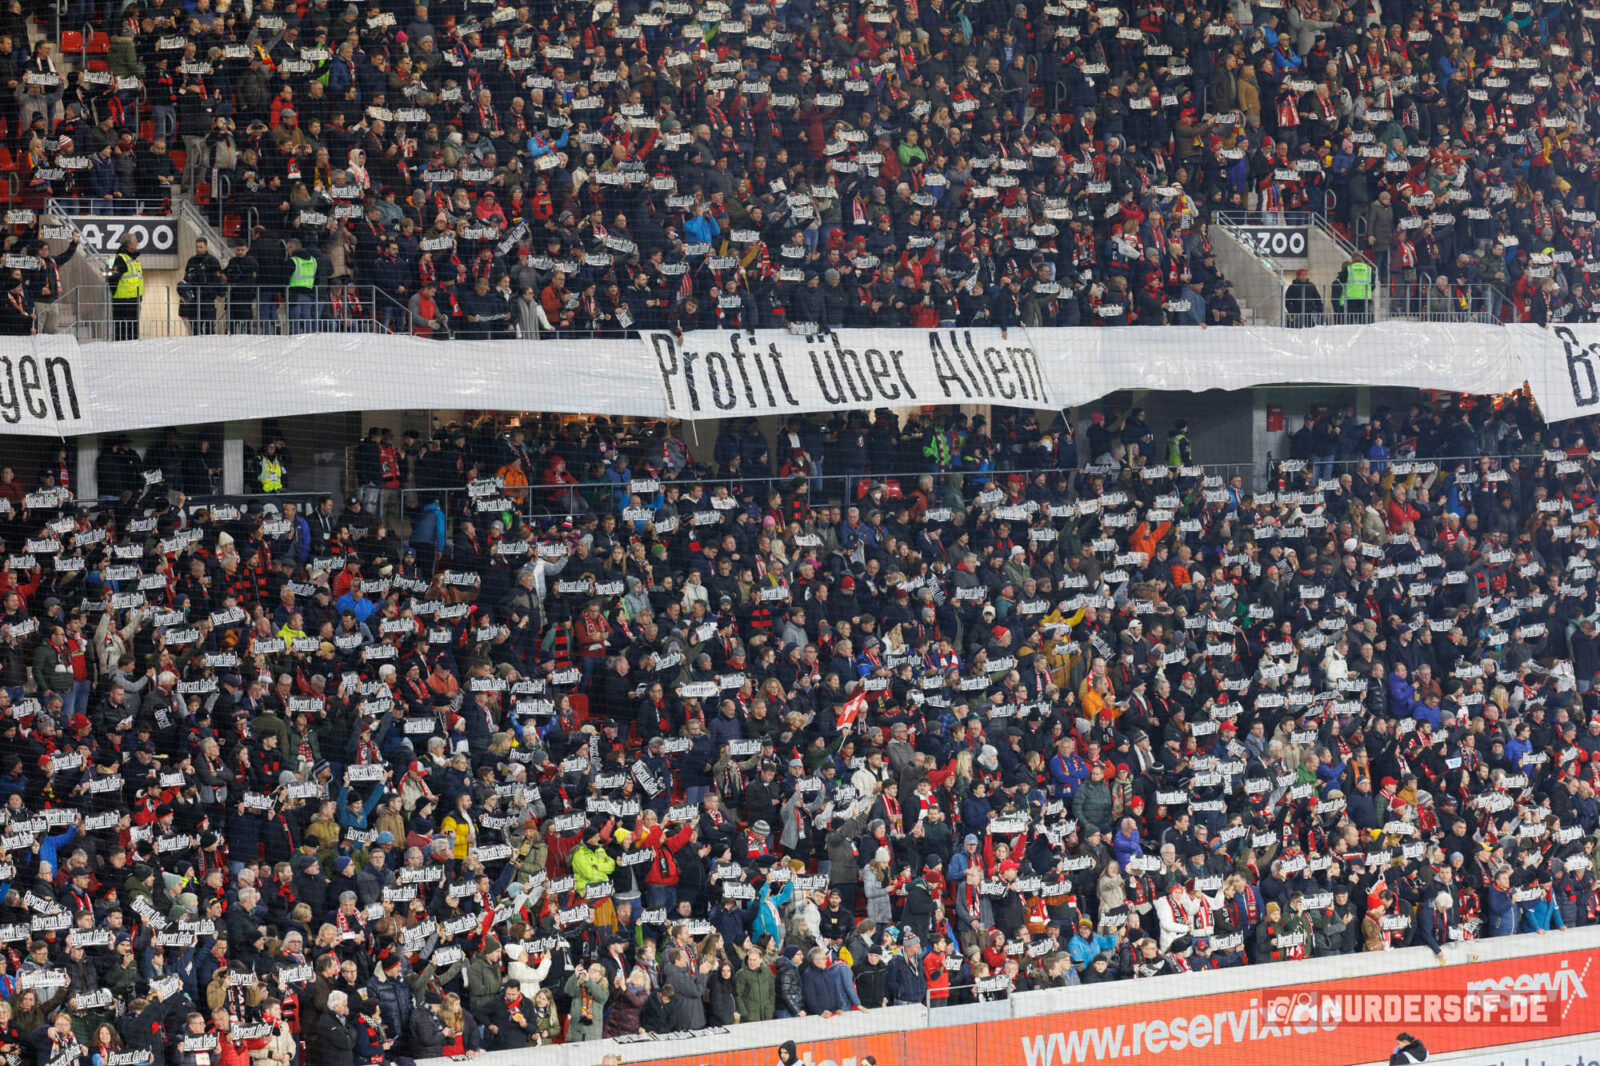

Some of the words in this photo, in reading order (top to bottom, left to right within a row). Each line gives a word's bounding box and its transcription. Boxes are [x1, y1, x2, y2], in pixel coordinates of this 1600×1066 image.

[82, 224, 173, 250] AZOO
[650, 332, 800, 411] Profit
[806, 331, 917, 405] über
[929, 330, 1048, 404] Allem
[1553, 326, 1600, 407] B
[24, 891, 48, 913] Boycott
[1467, 960, 1590, 1012] reservix
